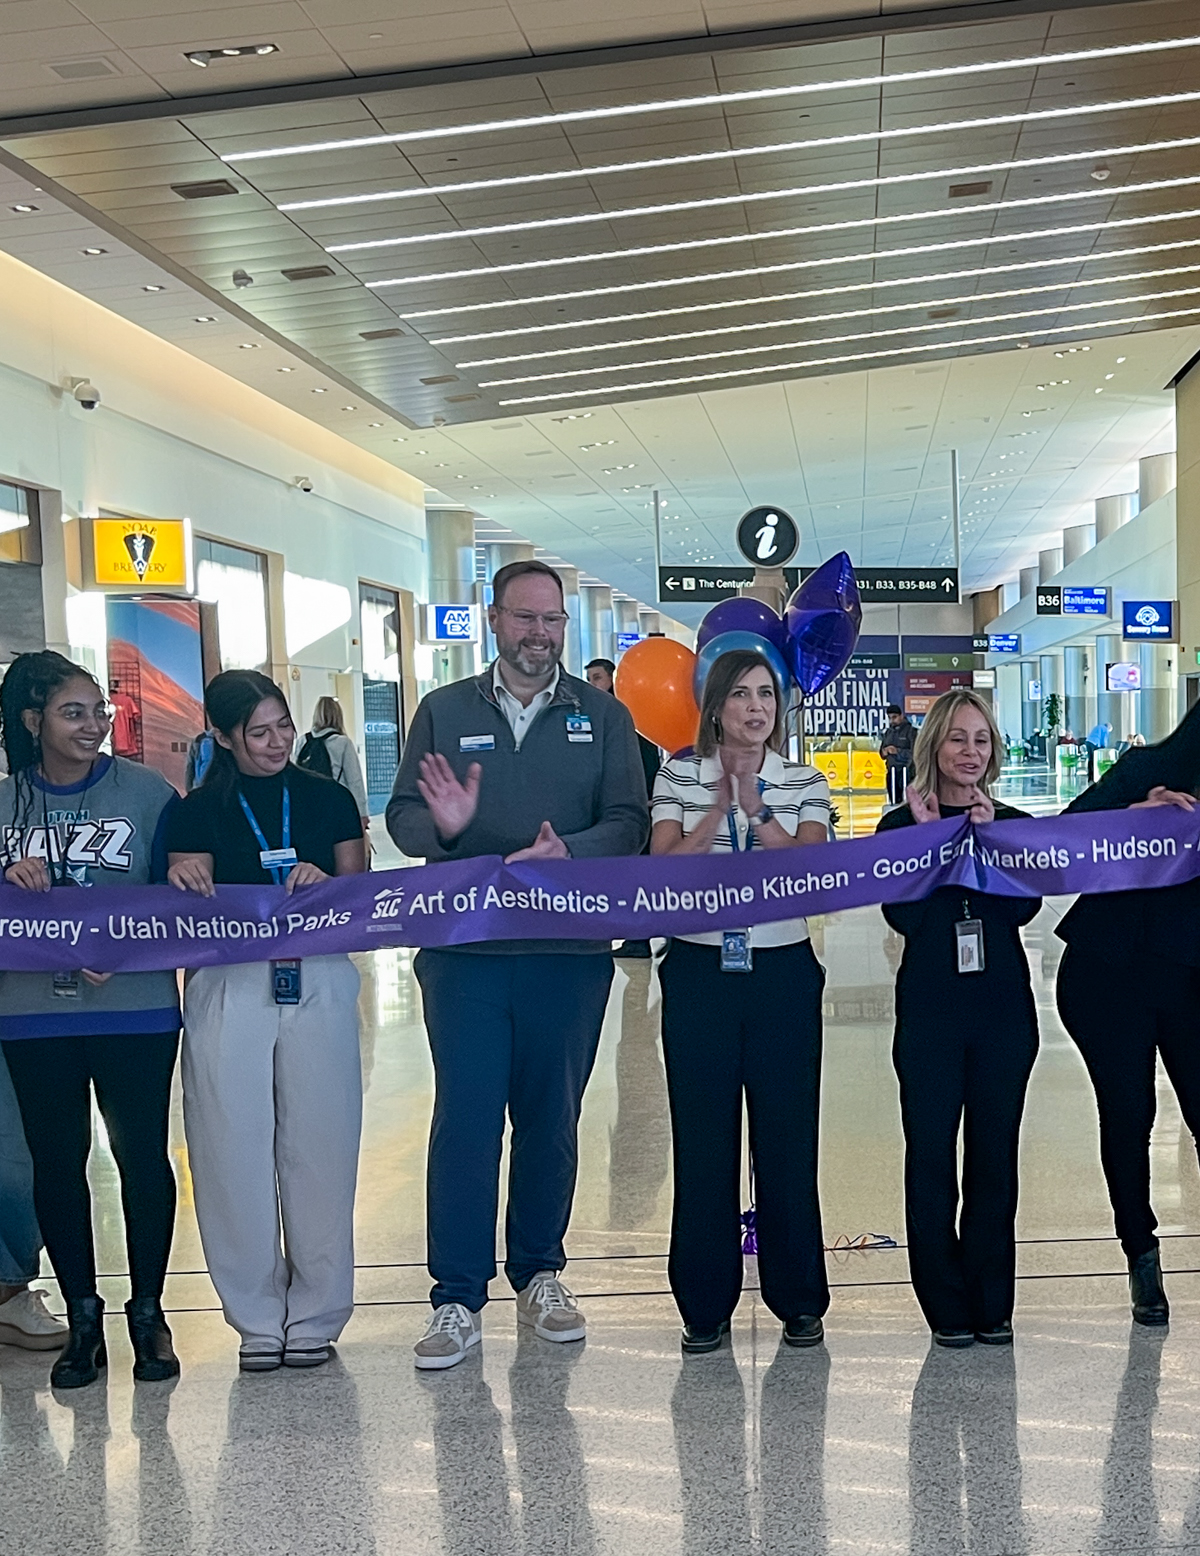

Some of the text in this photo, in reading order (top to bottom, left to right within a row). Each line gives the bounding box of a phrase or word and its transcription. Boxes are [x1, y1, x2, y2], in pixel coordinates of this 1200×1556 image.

[122, 522, 157, 535] MOAB
[699, 579, 714, 588] The
[1038, 595, 1060, 606] B36
[1064, 595, 1105, 605] Baltimore
[446, 612, 471, 622] AM
[842, 681, 891, 707] FINAL
[804, 708, 890, 735] APPROACH
[42, 809, 90, 825] UTAH
[0, 817, 136, 872] JAZZ
[409, 892, 445, 916] Art
[453, 886, 478, 912] of
[483, 885, 609, 914] Aesthetics
[633, 883, 754, 915] Aubergine
[762, 868, 849, 900] Kitchen
[873, 849, 932, 880] Good
[940, 834, 975, 866] Eart
[981, 845, 1070, 869] Markets
[1091, 836, 1177, 863] Hudson
[371, 897, 402, 919] SLC
[109, 915, 167, 940] Utah
[176, 915, 279, 939] National
[287, 908, 351, 935] Parks
